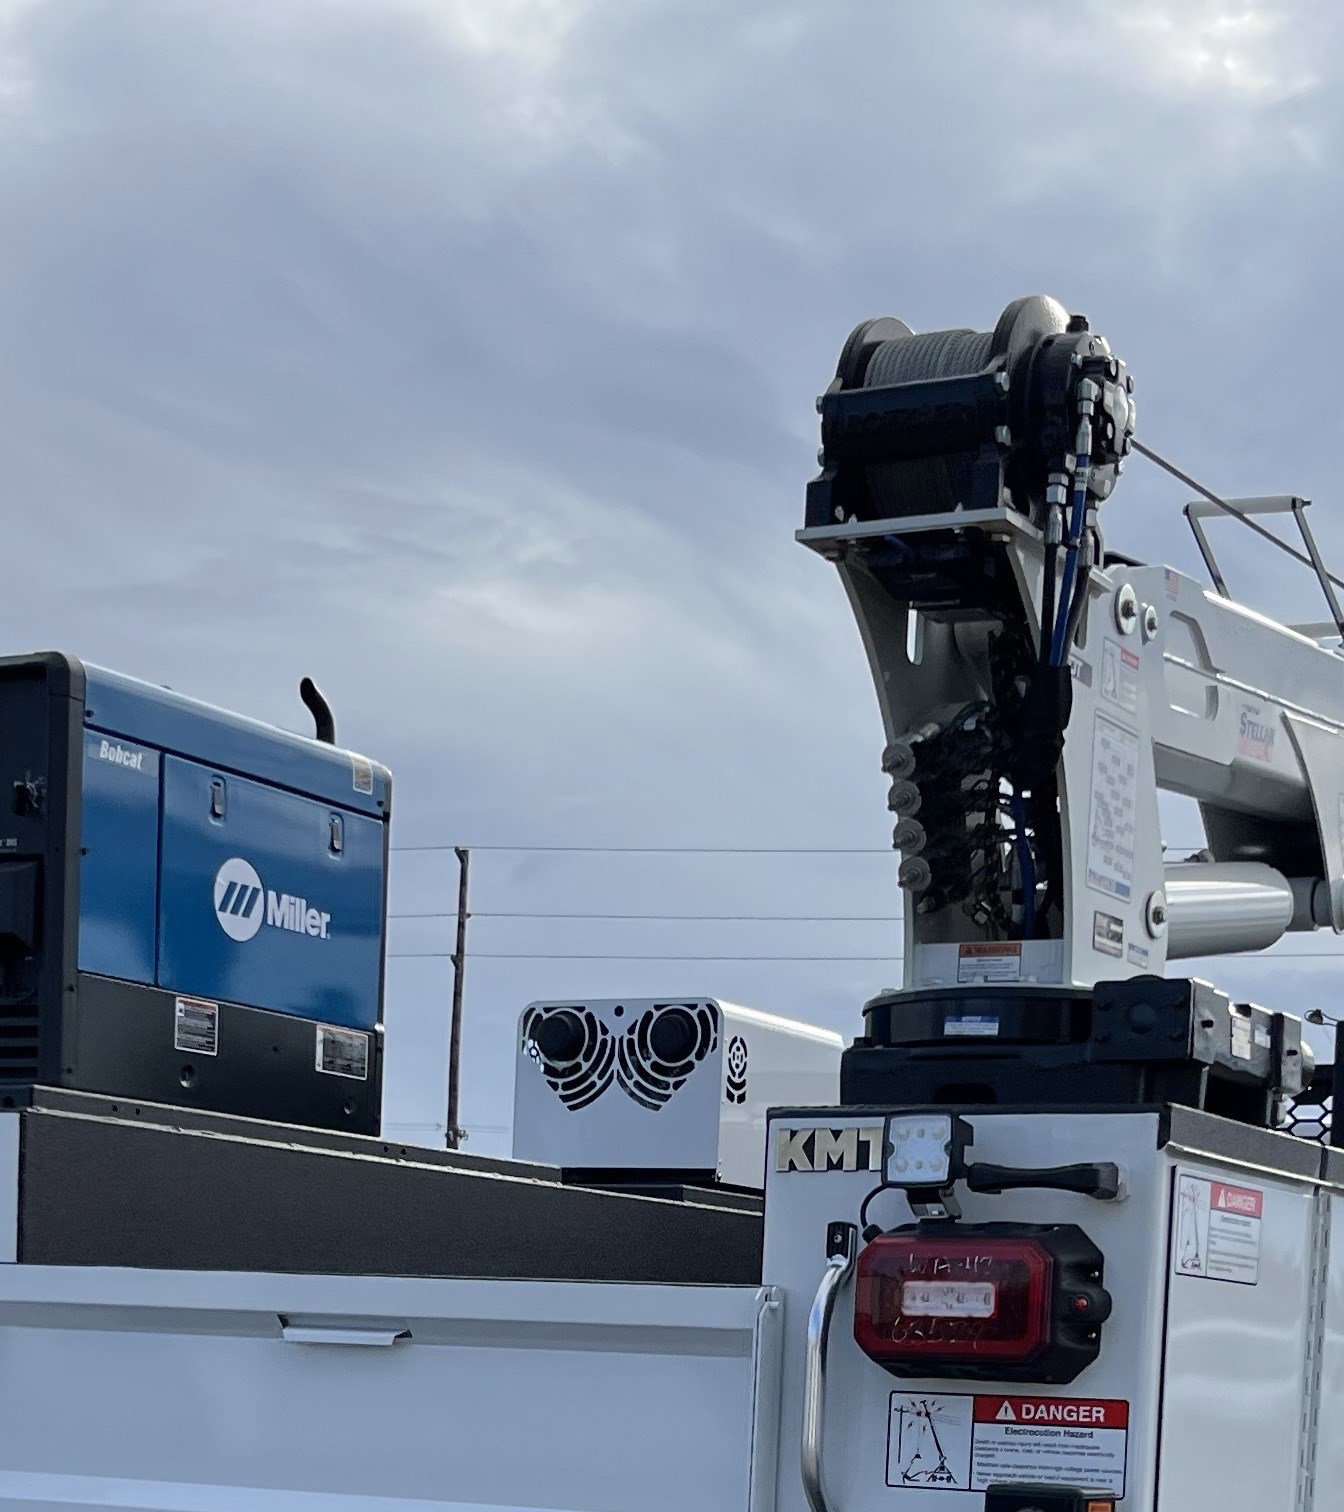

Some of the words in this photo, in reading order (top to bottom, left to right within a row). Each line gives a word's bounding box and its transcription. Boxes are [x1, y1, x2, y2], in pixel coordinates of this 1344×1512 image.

[99, 740, 143, 770] Bobcat
[266, 889, 331, 939] Miller
[1021, 1403, 1105, 1423] DANGER
[1004, 1426, 1061, 1438] Electrocution
[1063, 1430, 1094, 1439] Hazard
